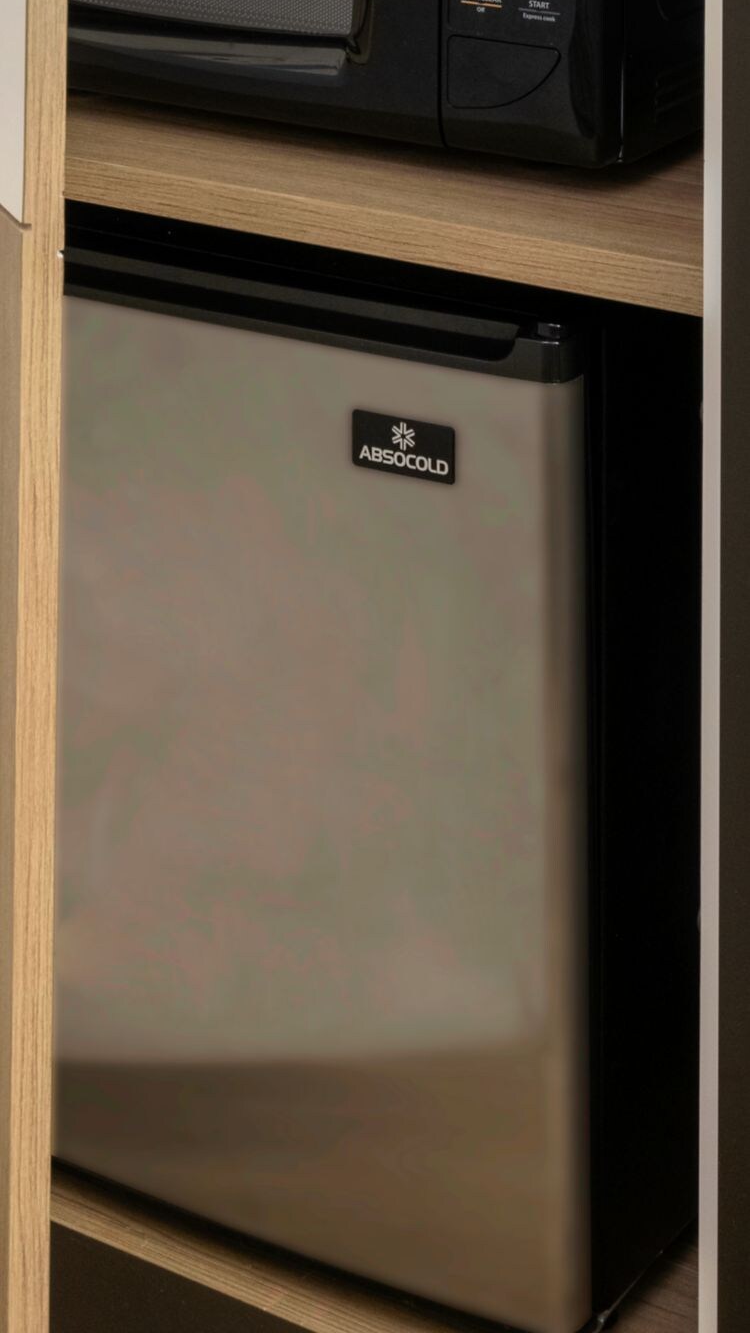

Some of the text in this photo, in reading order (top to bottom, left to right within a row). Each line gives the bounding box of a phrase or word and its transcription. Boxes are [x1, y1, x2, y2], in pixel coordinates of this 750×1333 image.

[528, 0, 550, 9] START
[522, 12, 556, 22] Express cook
[359, 445, 449, 475] ABSOCOLD
